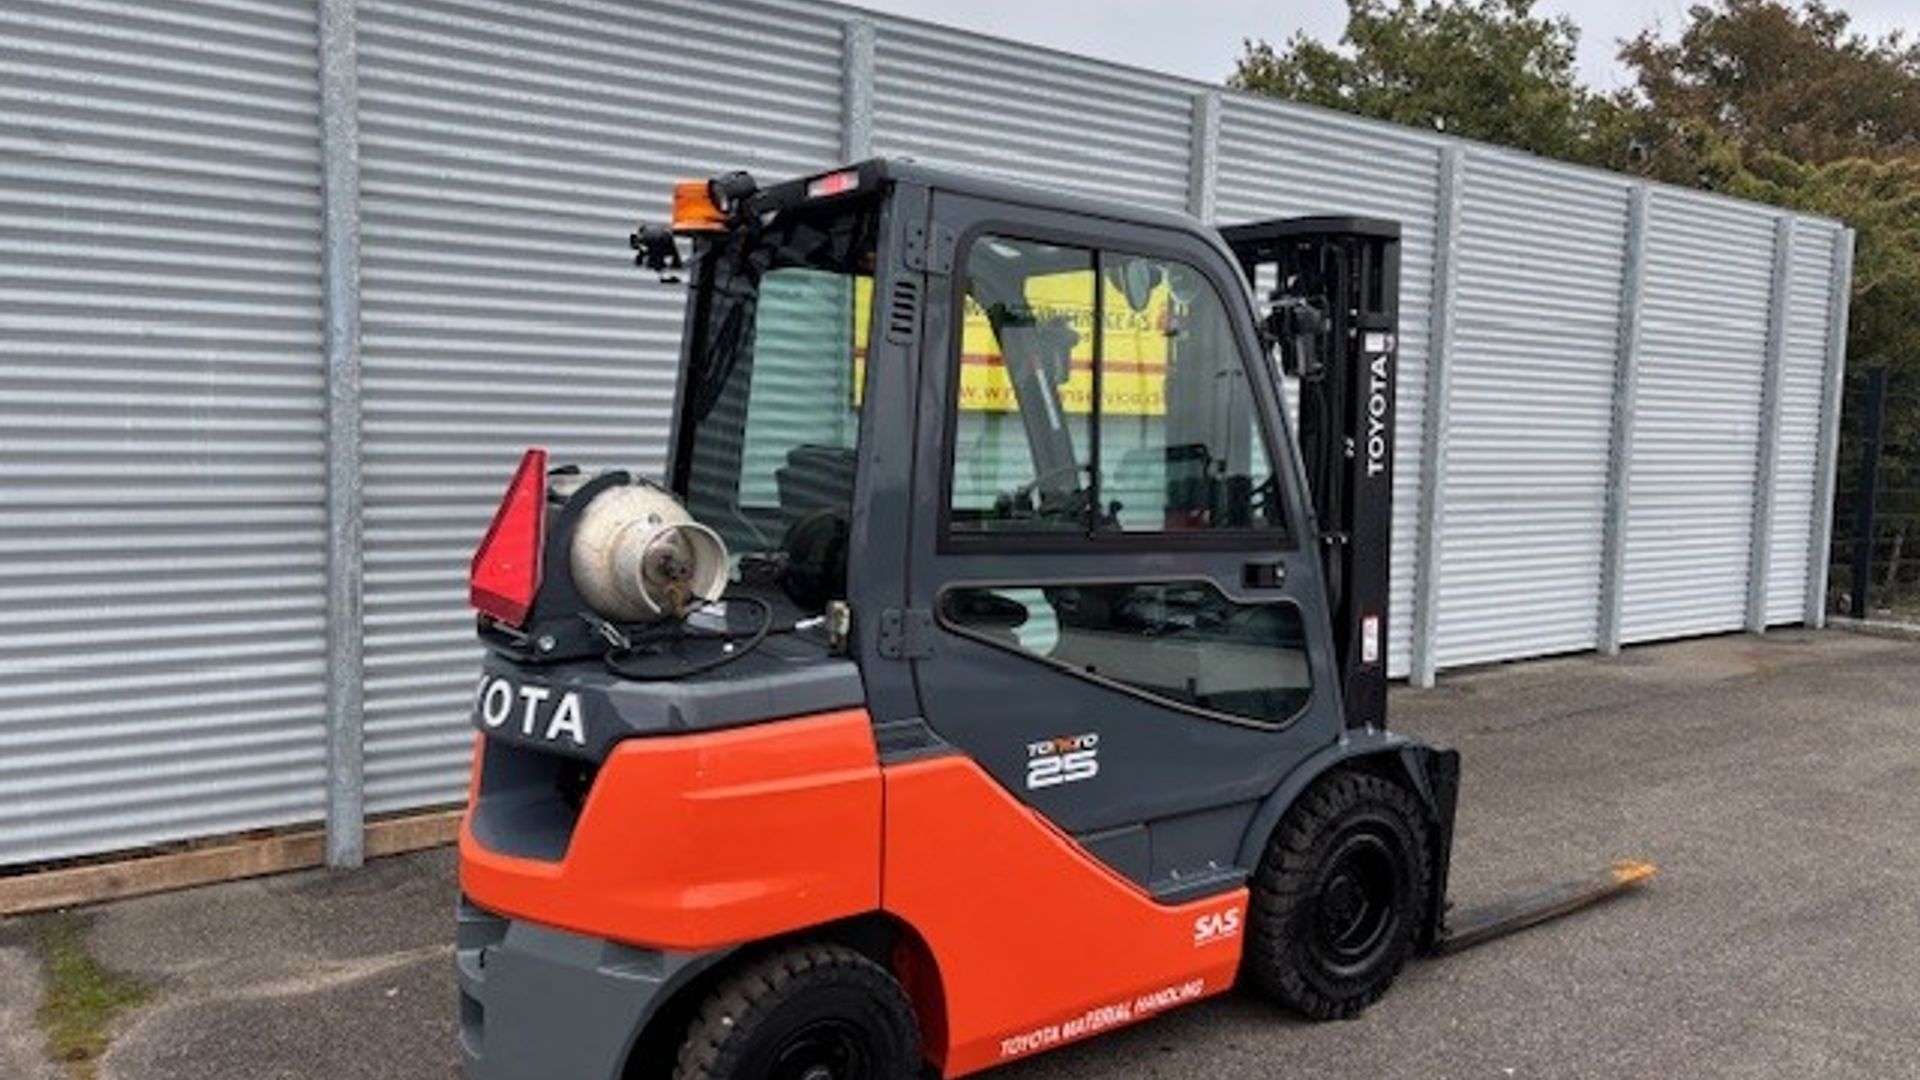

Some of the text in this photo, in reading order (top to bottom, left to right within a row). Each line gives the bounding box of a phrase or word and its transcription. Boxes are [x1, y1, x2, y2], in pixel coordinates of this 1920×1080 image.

[1367, 355, 1388, 477] TOYOTA
[476, 675, 587, 745] OTA
[1026, 749, 1099, 789] 25
[1194, 907, 1240, 940] SAS
[1000, 977, 1204, 1057] TOYOTA MATERIAL HANDLING
